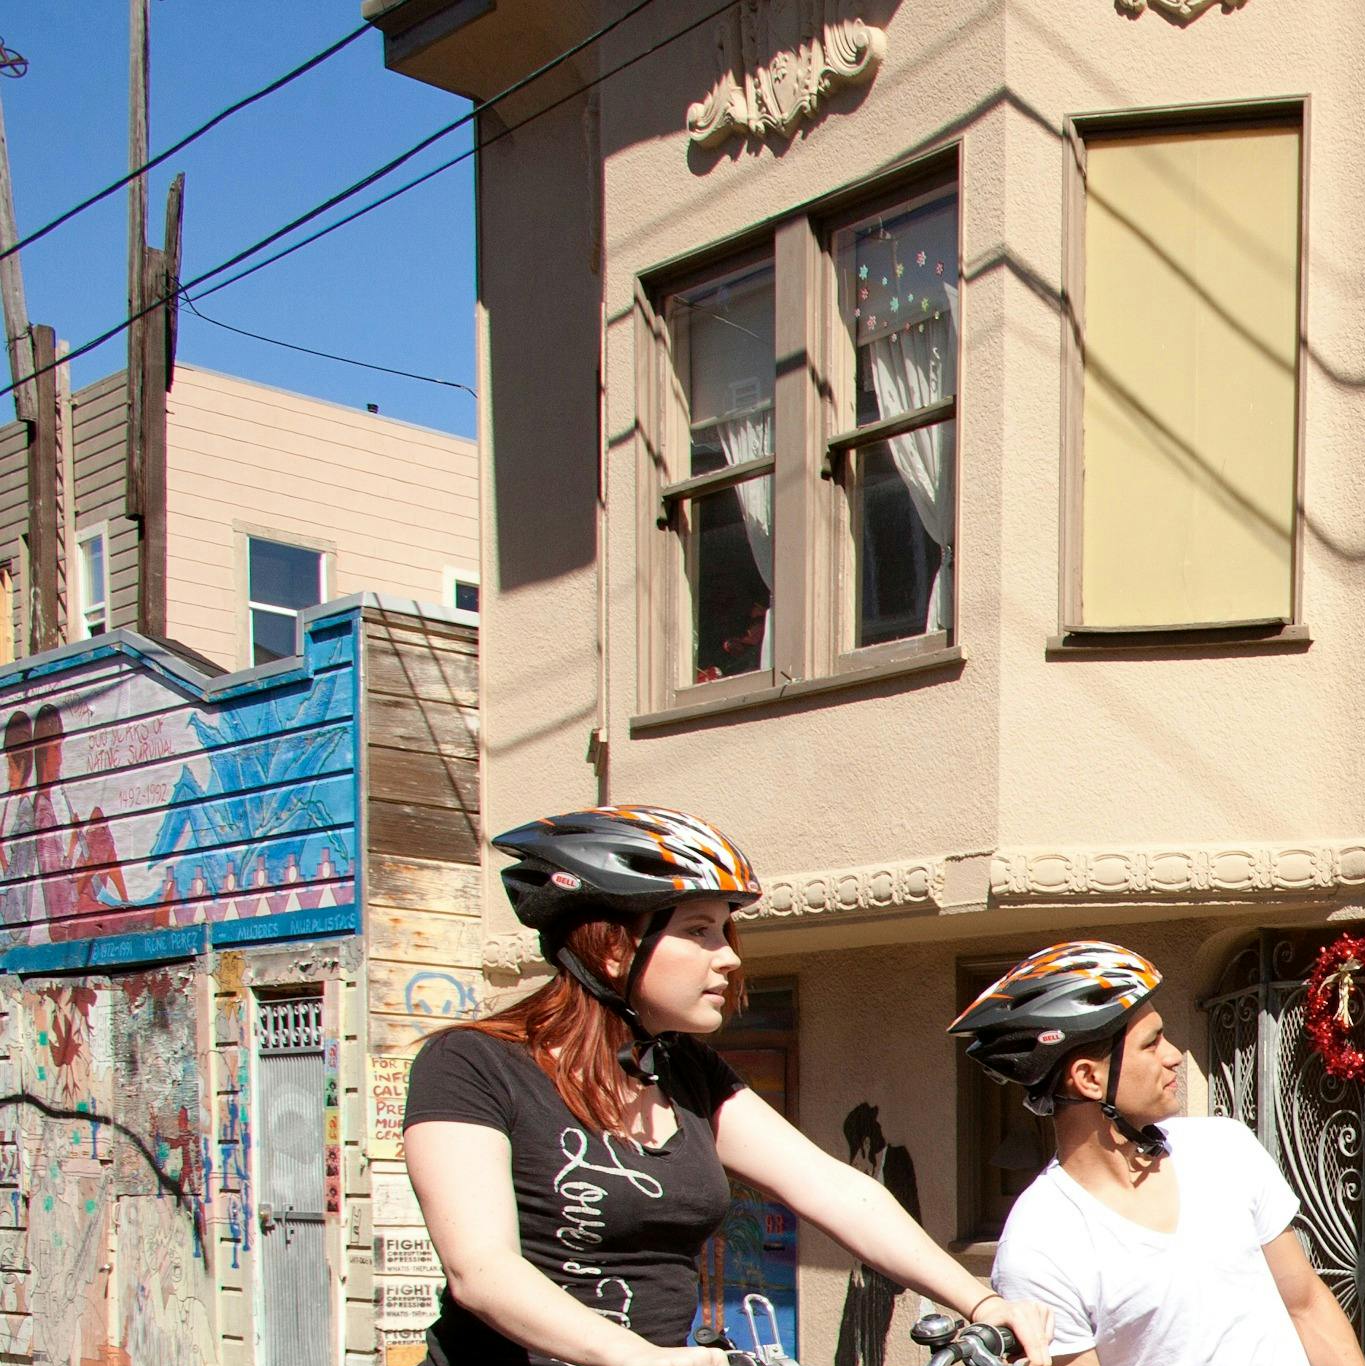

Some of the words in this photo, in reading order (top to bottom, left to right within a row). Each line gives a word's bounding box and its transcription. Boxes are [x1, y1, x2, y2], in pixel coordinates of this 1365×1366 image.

[556, 876, 575, 887] BELL
[238, 923, 278, 941] MUJERES
[371, 1058, 398, 1069] FOR
[387, 1239, 431, 1250] FIGHT
[386, 1284, 431, 1295] FIGHT
